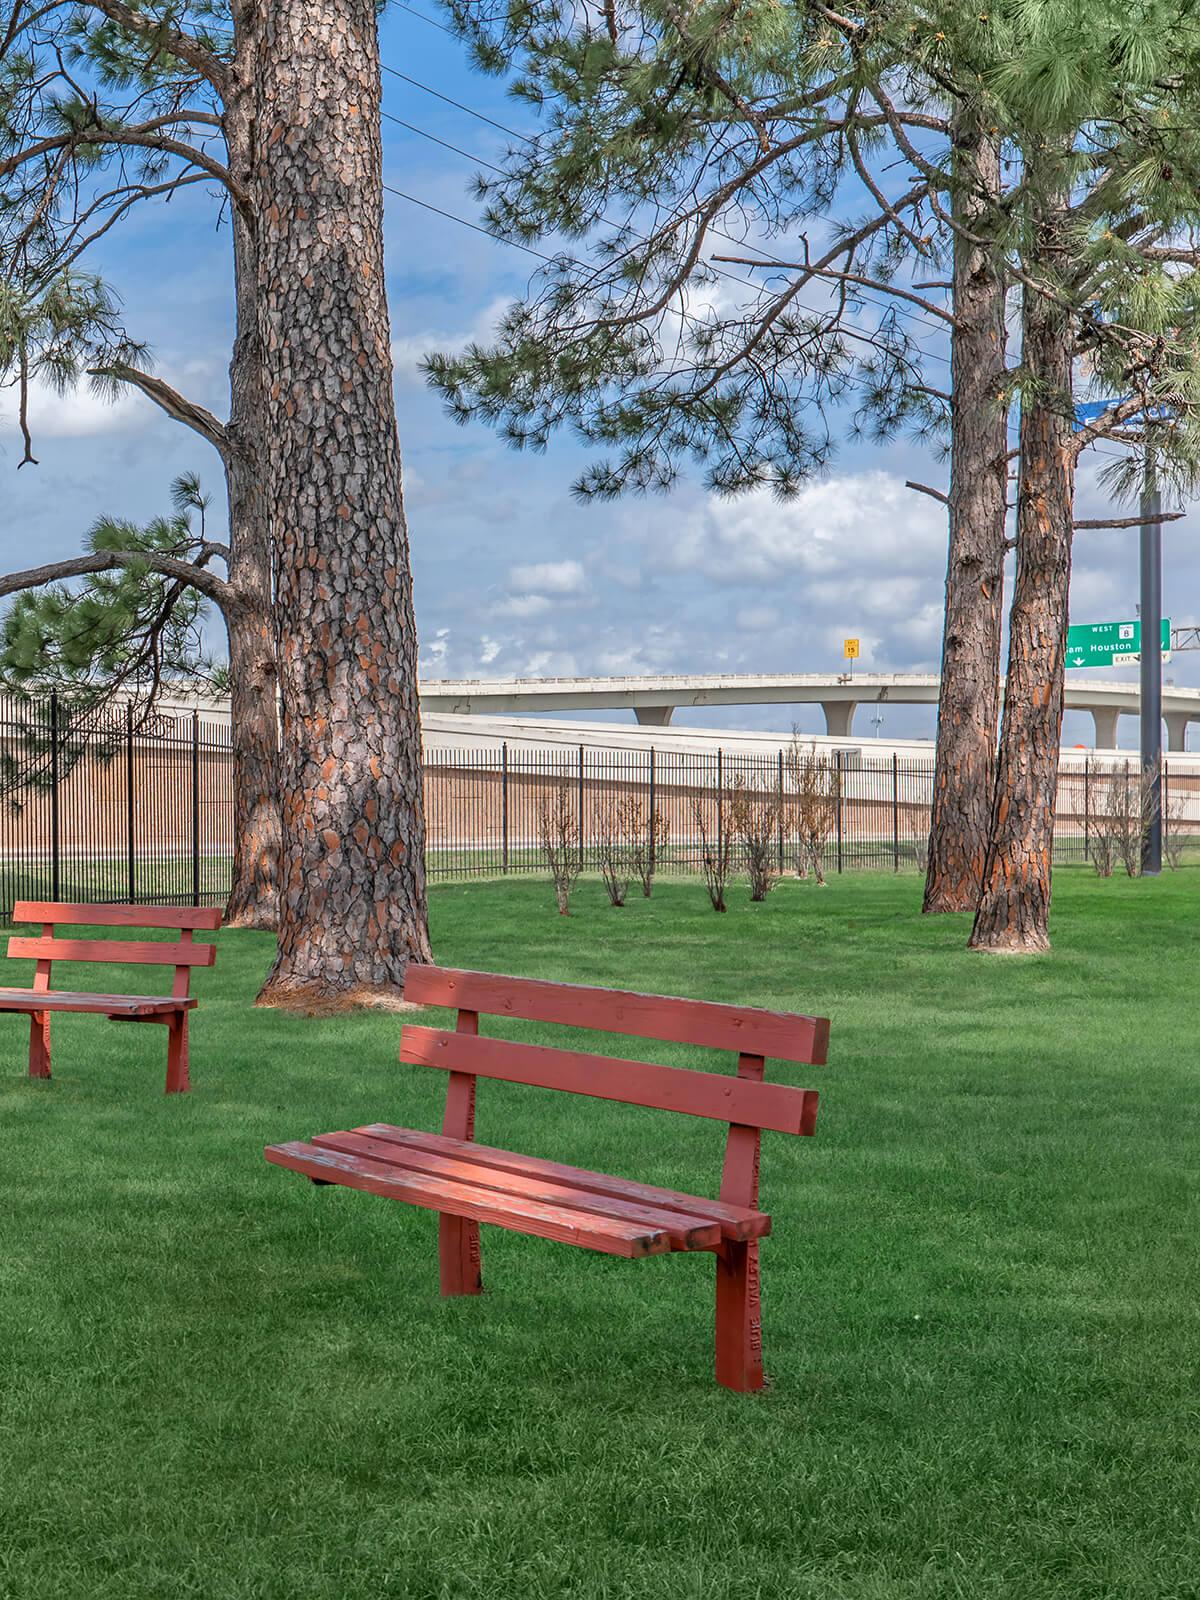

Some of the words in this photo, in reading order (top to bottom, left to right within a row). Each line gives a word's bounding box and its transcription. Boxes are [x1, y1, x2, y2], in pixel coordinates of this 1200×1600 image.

[1092, 625, 1113, 633] WEST
[1123, 629, 1130, 638] 8
[1090, 643, 1132, 652] Houston
